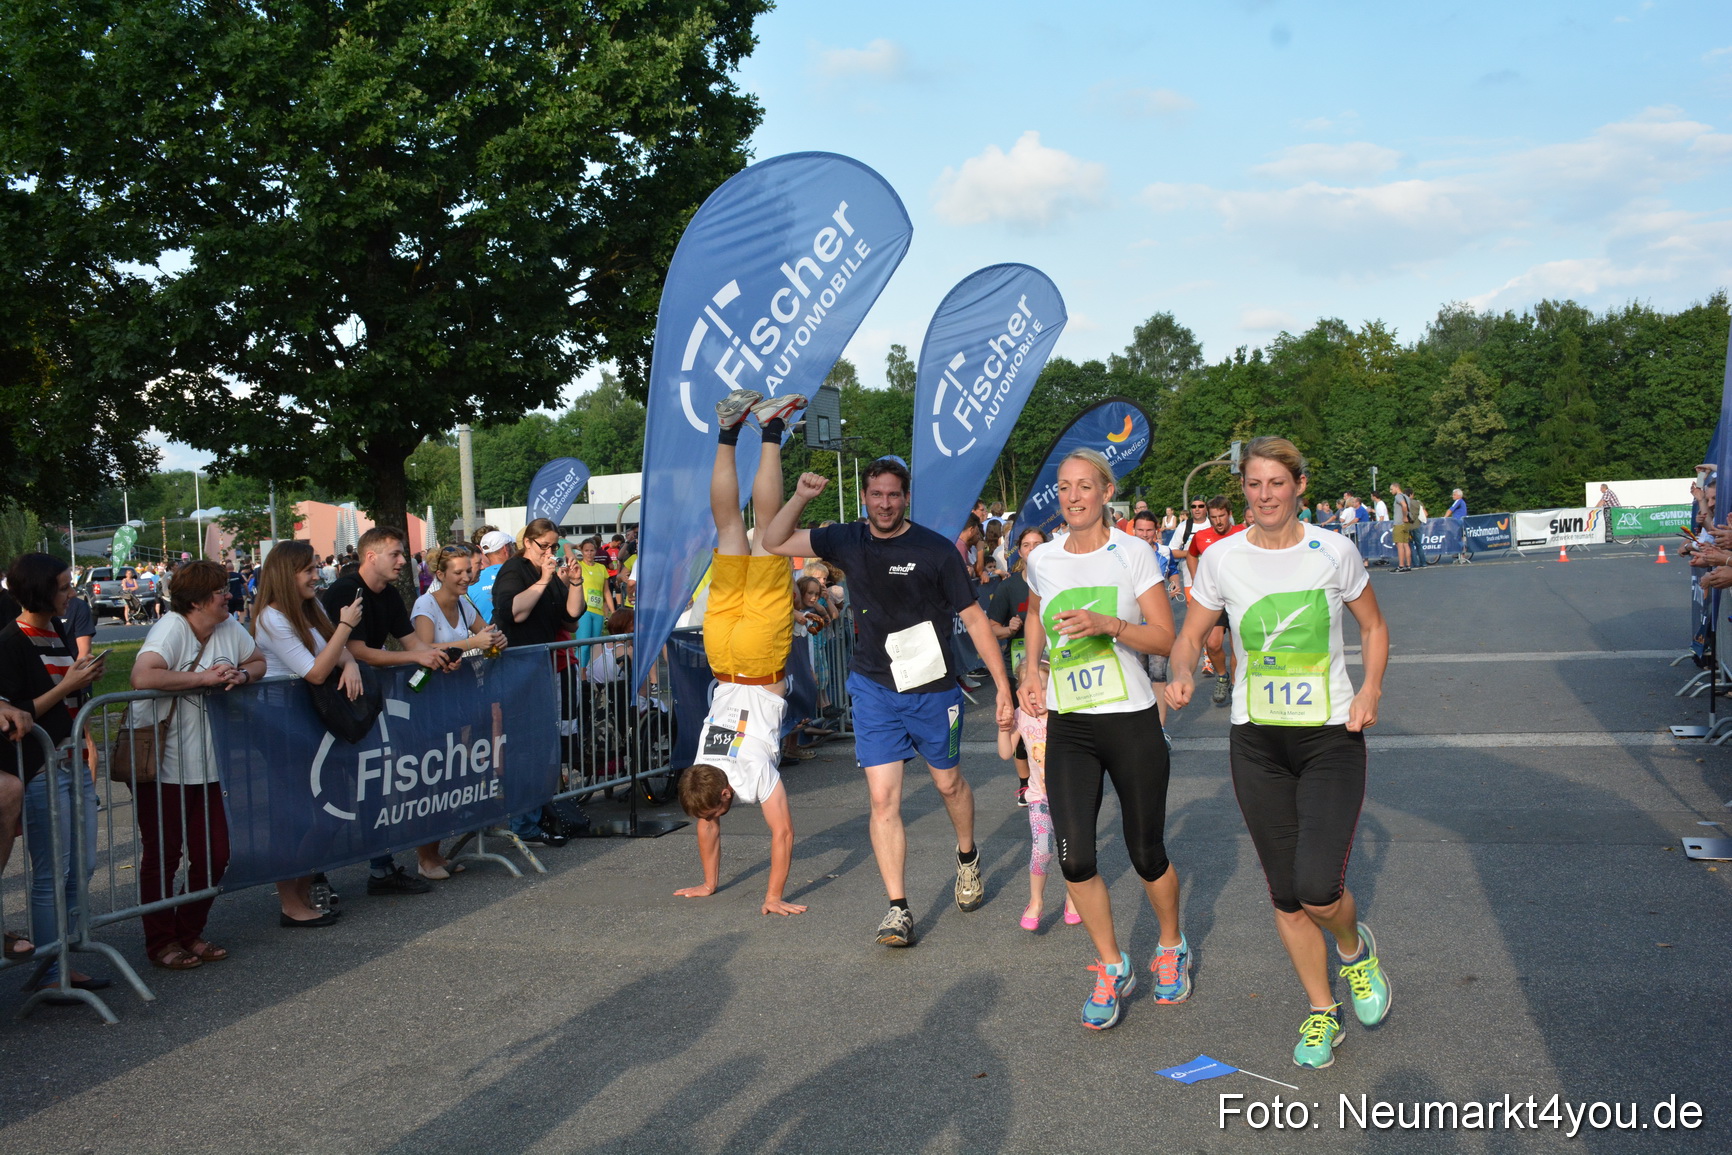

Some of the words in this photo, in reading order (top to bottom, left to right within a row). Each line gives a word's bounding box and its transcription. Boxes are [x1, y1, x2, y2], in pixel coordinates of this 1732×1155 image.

[714, 200, 854, 391] Fischer
[765, 238, 871, 397] AUTOMOBILE
[953, 294, 1033, 433] Fischer
[984, 319, 1044, 430] AUTOMOBILE
[1121, 437, 1146, 460] Medien
[541, 467, 576, 515] Fischer
[553, 475, 581, 515] AUTOMOBILE
[1466, 526, 1500, 538] Frischmann
[1549, 517, 1584, 535] swn
[1617, 512, 1642, 526] AOK
[1066, 664, 1106, 693] 107
[1263, 681, 1313, 706] 112
[356, 732, 507, 802] Fischer
[373, 778, 500, 830] AUTOMOBILE
